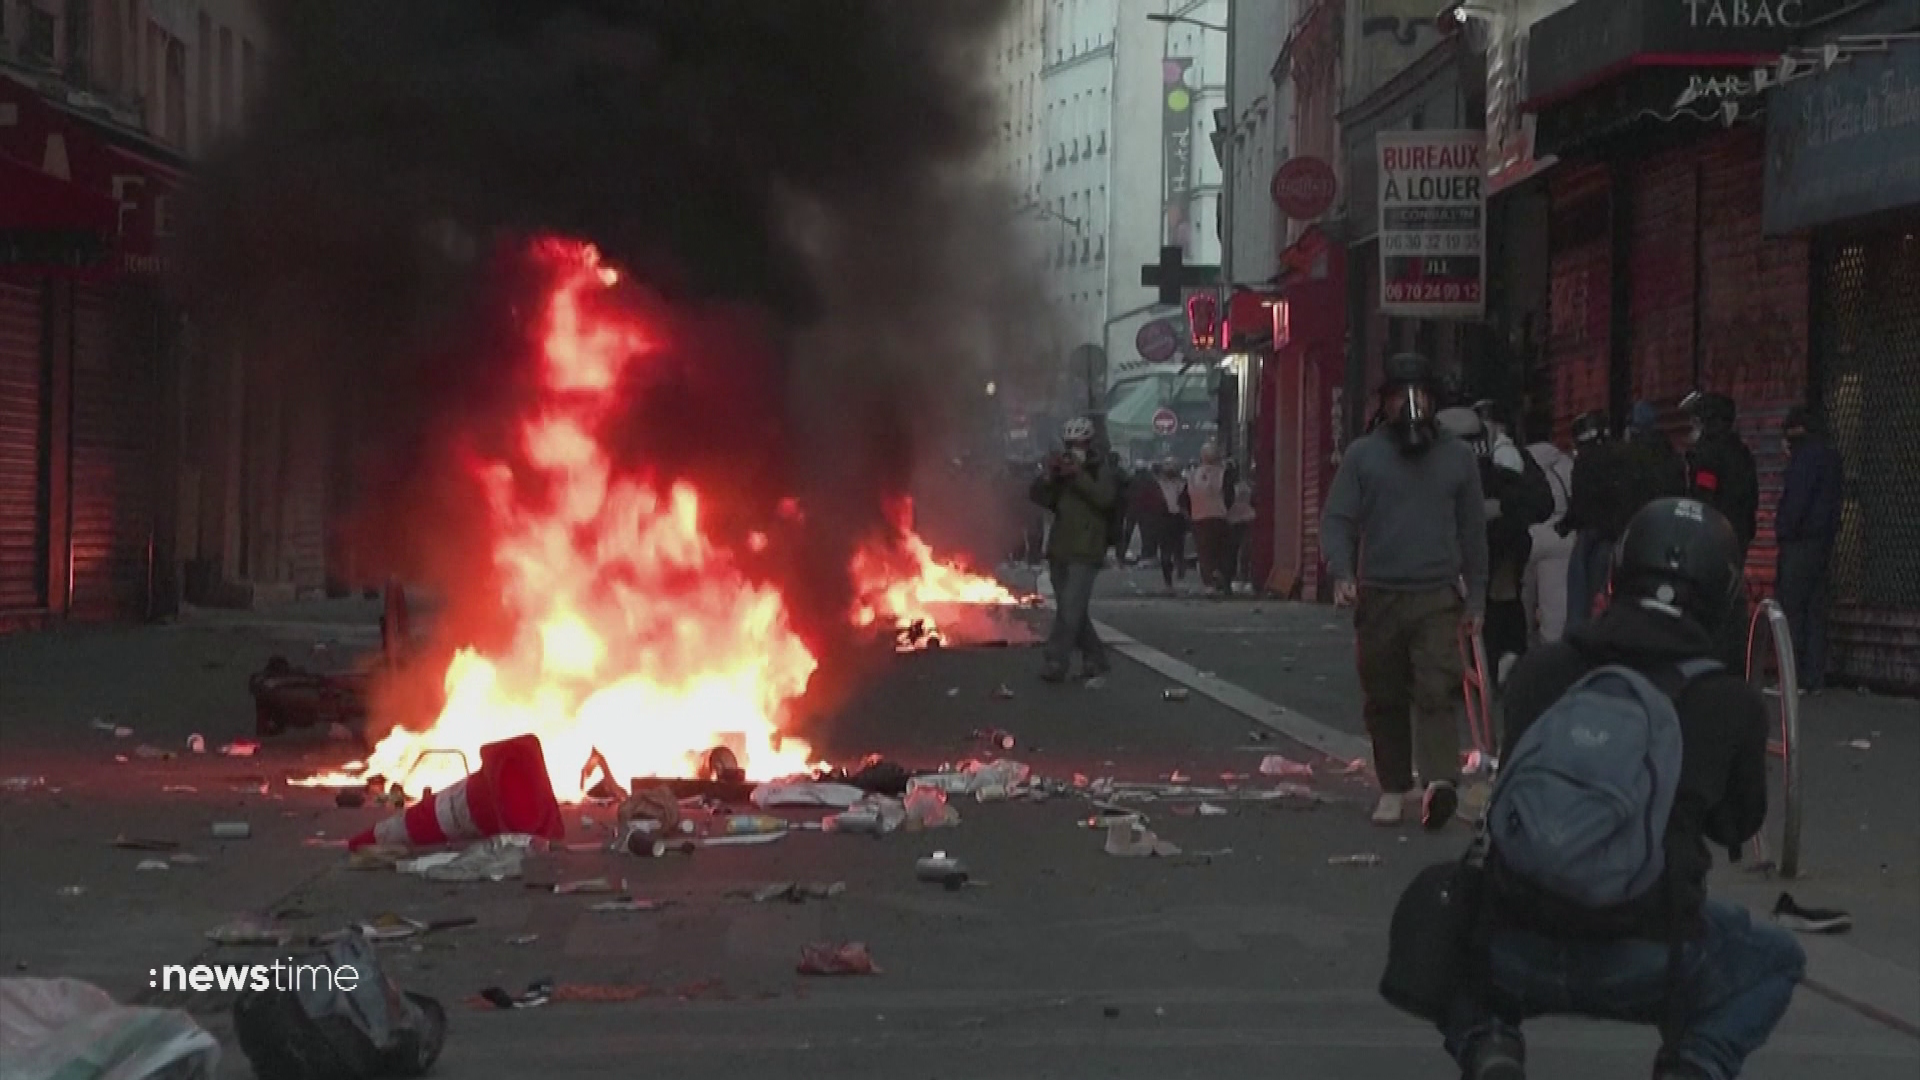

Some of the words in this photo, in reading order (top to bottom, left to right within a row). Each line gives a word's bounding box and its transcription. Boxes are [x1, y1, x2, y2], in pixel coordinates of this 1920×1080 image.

[1682, 0, 1802, 27] TABAC
[1383, 145, 1480, 170] BUREAUX
[1407, 176, 1480, 201] LOUER
[1405, 283, 1422, 300] 70
[1424, 283, 1441, 299] 24
